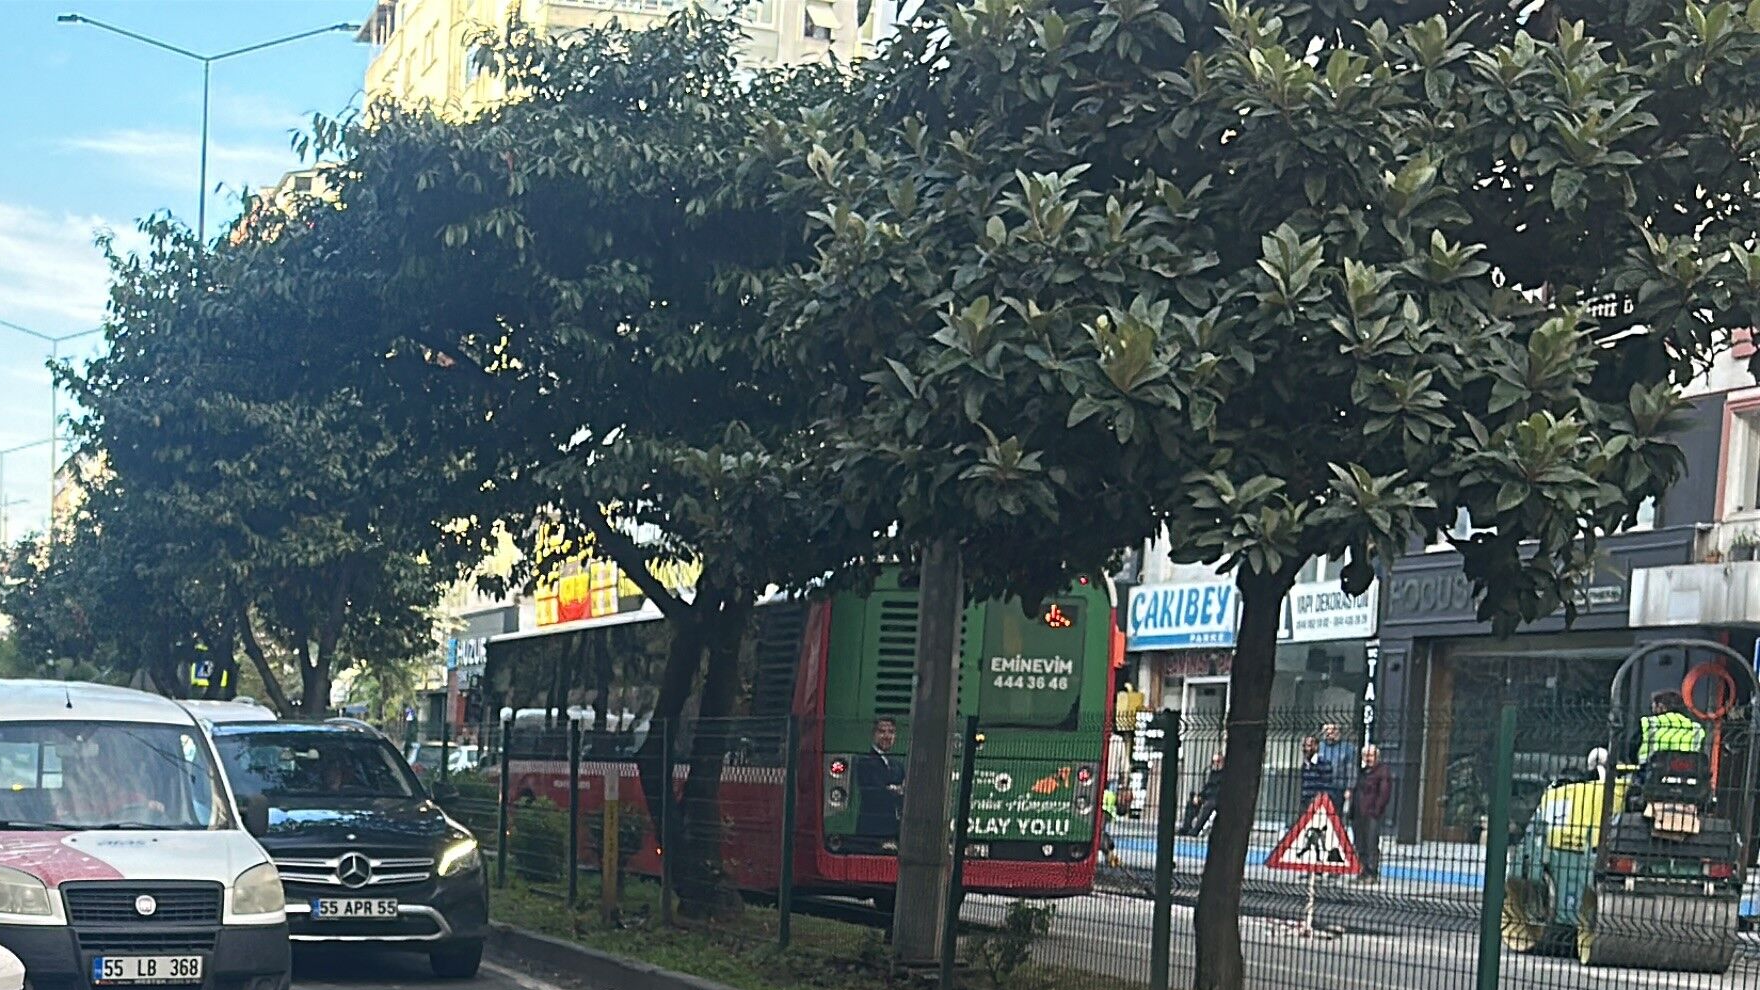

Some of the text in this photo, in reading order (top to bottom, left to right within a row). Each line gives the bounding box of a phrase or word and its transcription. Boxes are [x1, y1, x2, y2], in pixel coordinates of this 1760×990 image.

[1132, 585, 1231, 636] ÇAKIBEY
[991, 654, 1073, 674] EMİNEVİM
[993, 675, 1024, 688] 444
[1027, 676, 1046, 689] 36
[1016, 818, 1070, 836] YOLU
[320, 901, 395, 914] 55 APR 55
[104, 958, 198, 977] 55 LB 368
